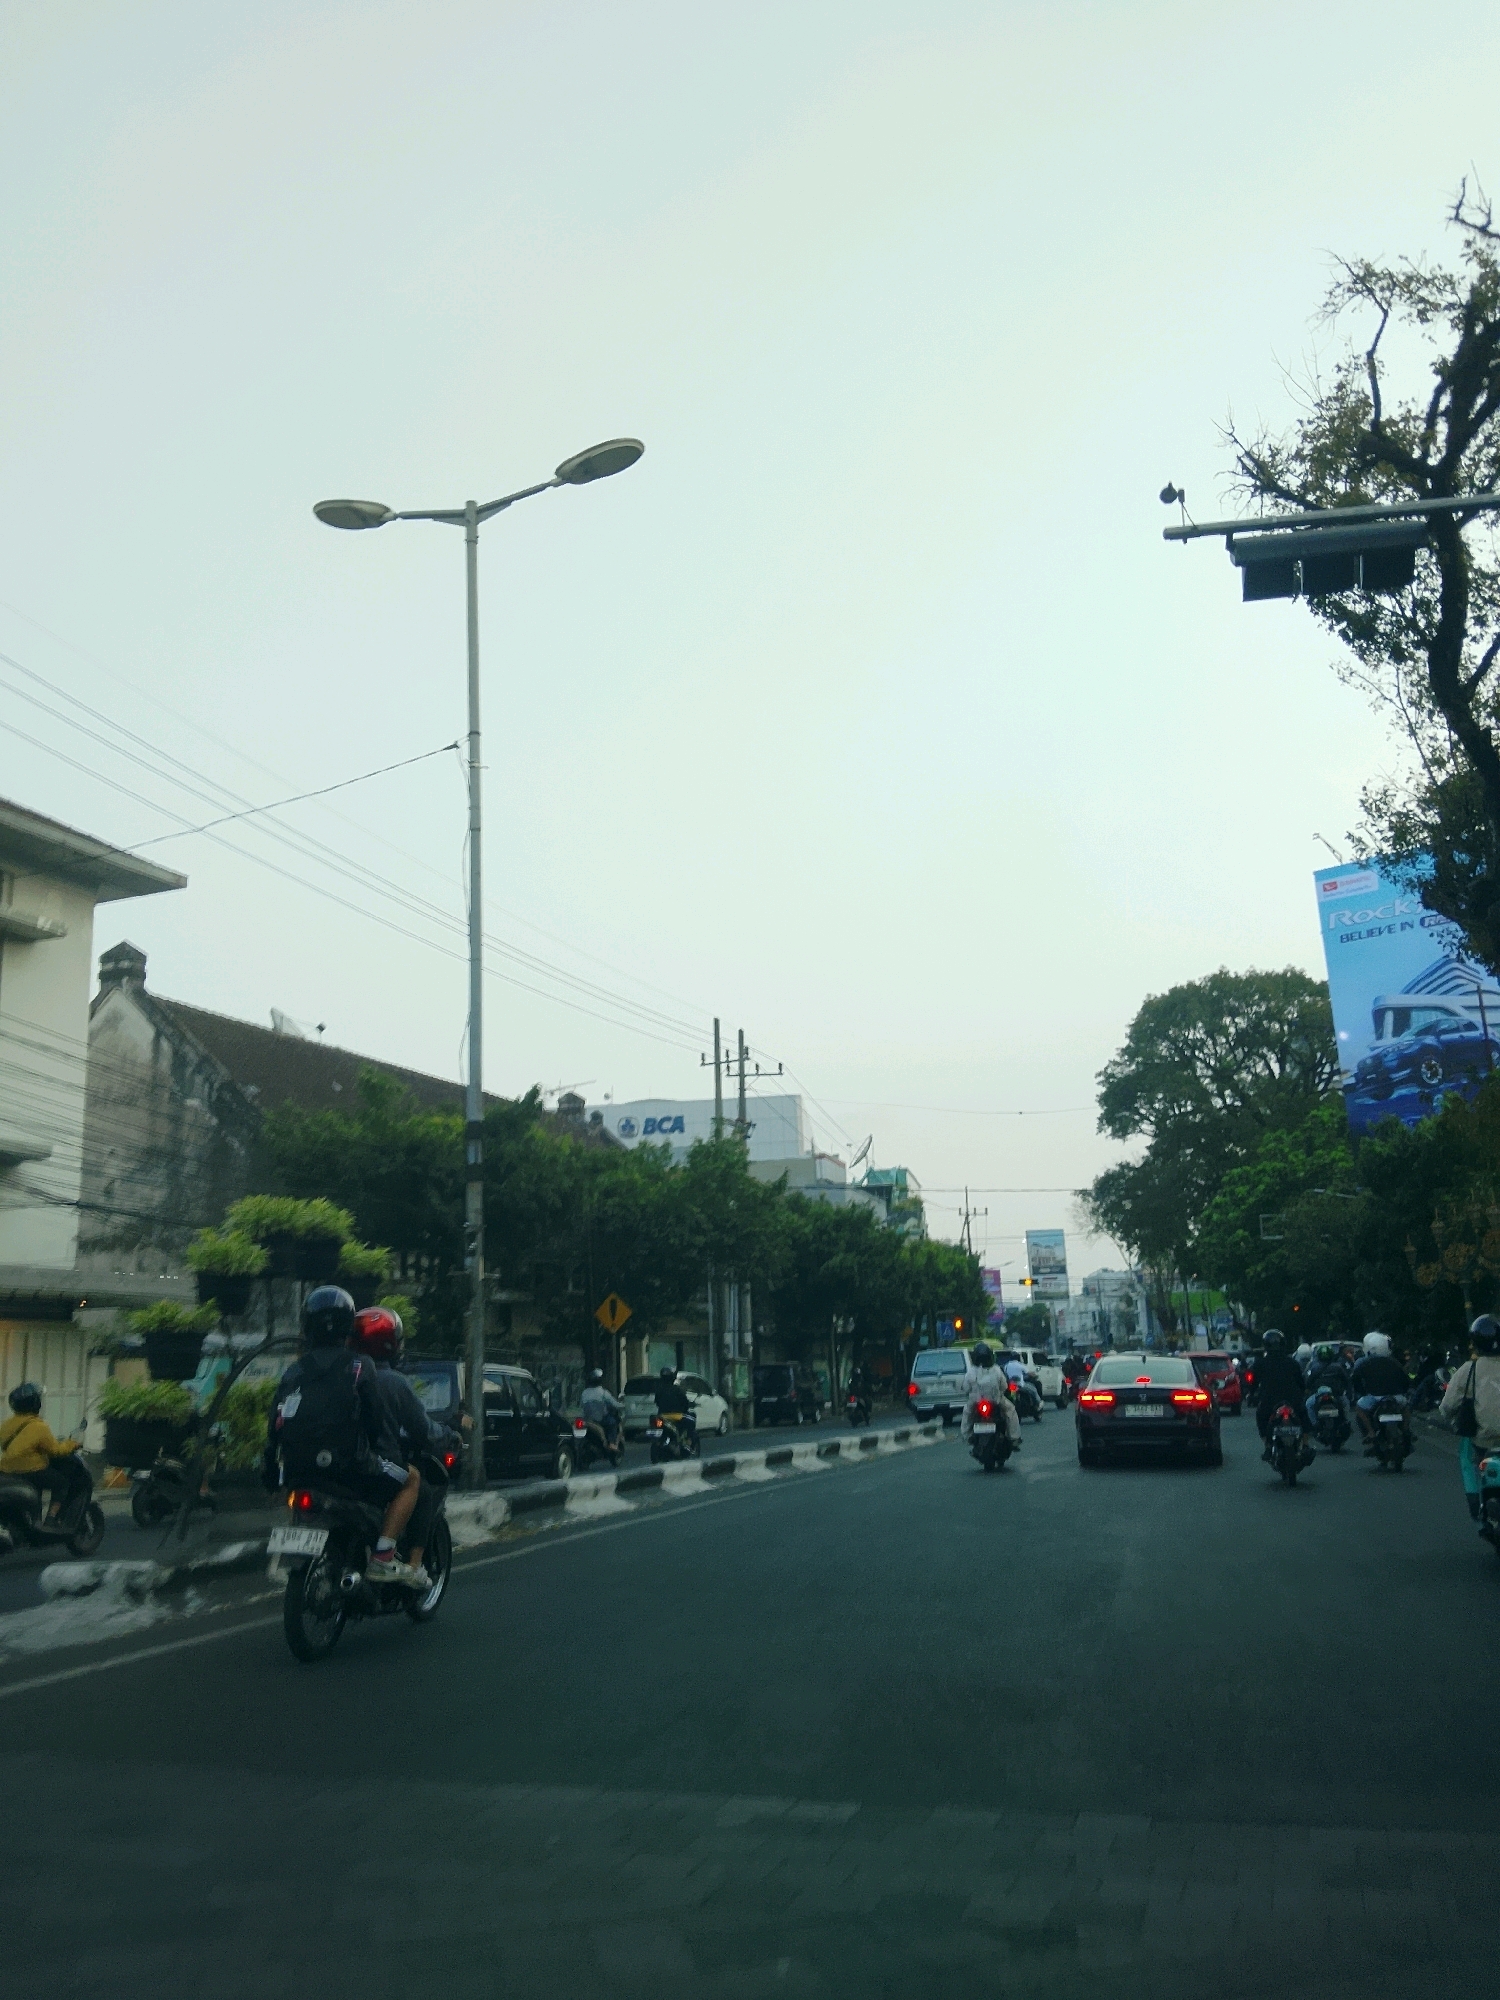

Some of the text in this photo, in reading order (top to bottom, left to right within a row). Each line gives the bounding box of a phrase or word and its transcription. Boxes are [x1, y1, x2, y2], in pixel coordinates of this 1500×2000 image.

[1340, 923, 1396, 943] BELIEVE
[1400, 920, 1414, 932] IN
[643, 1115, 685, 1135] BCA
